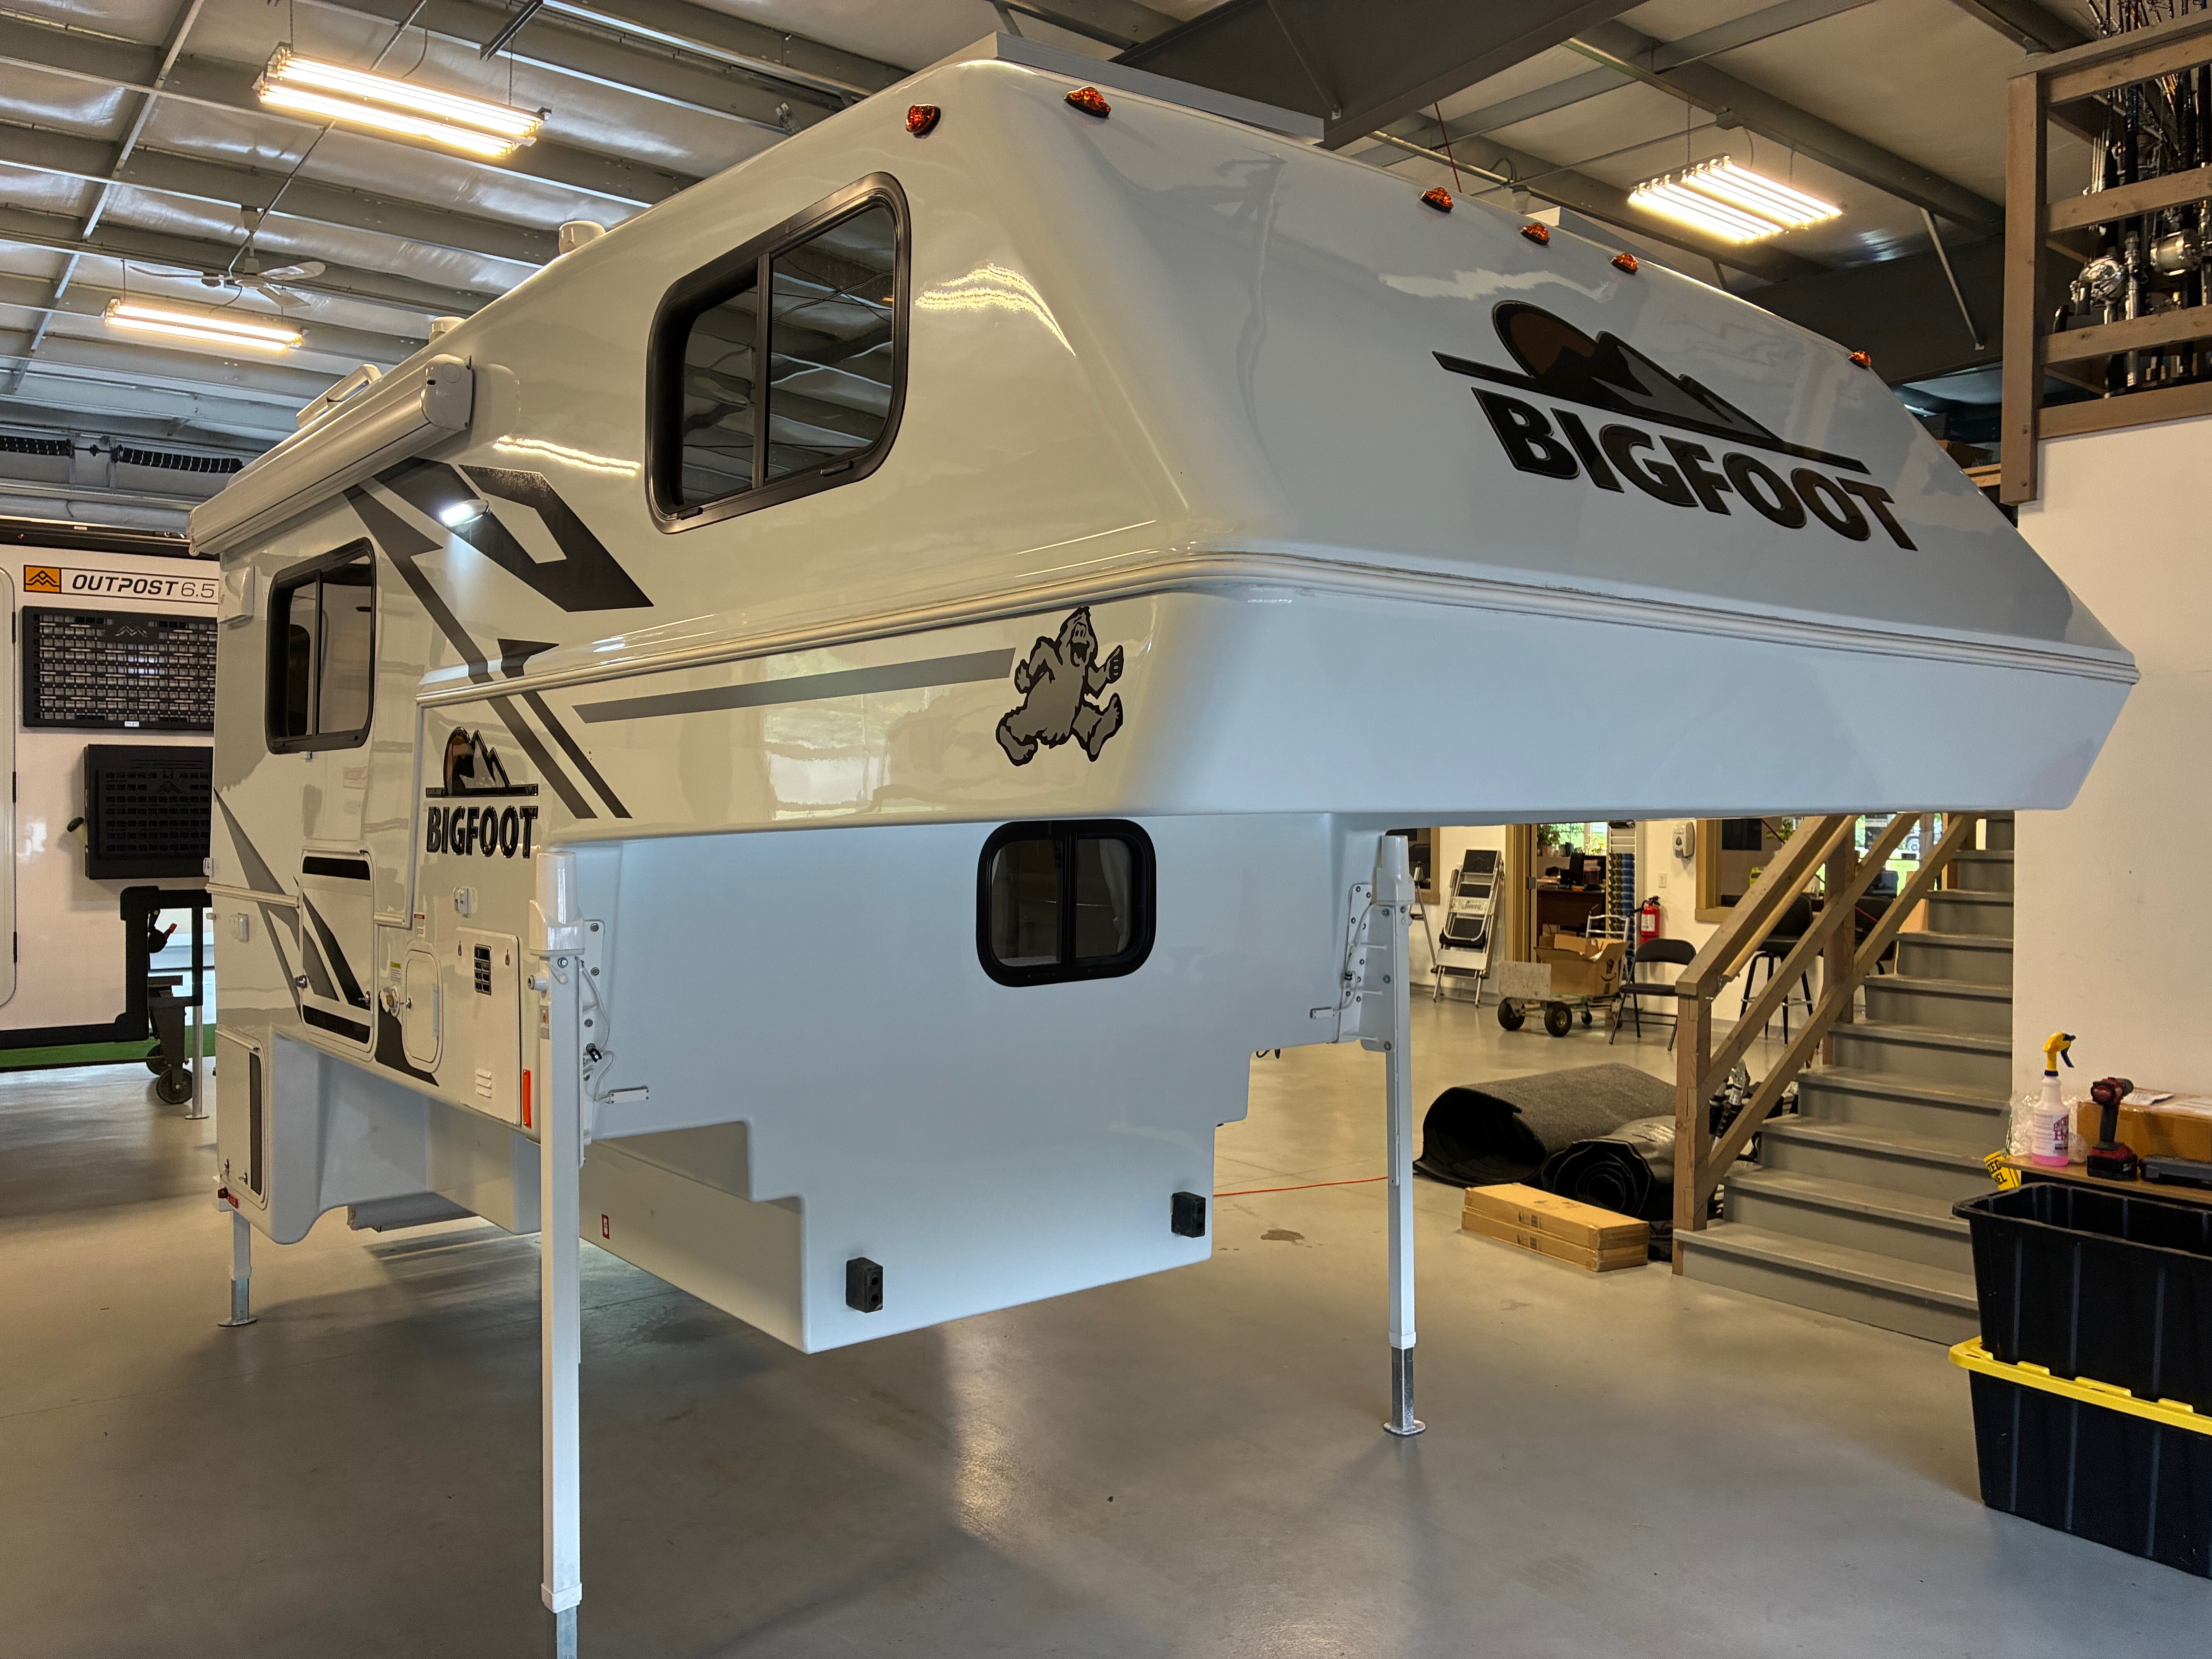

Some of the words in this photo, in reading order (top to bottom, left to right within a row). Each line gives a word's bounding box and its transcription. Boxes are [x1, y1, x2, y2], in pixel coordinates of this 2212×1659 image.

[1471, 387, 1918, 551] BIGFOOT
[72, 575, 179, 596] OUTPOST
[181, 582, 215, 598] 6.5
[426, 805, 538, 859] BIGFOOT
